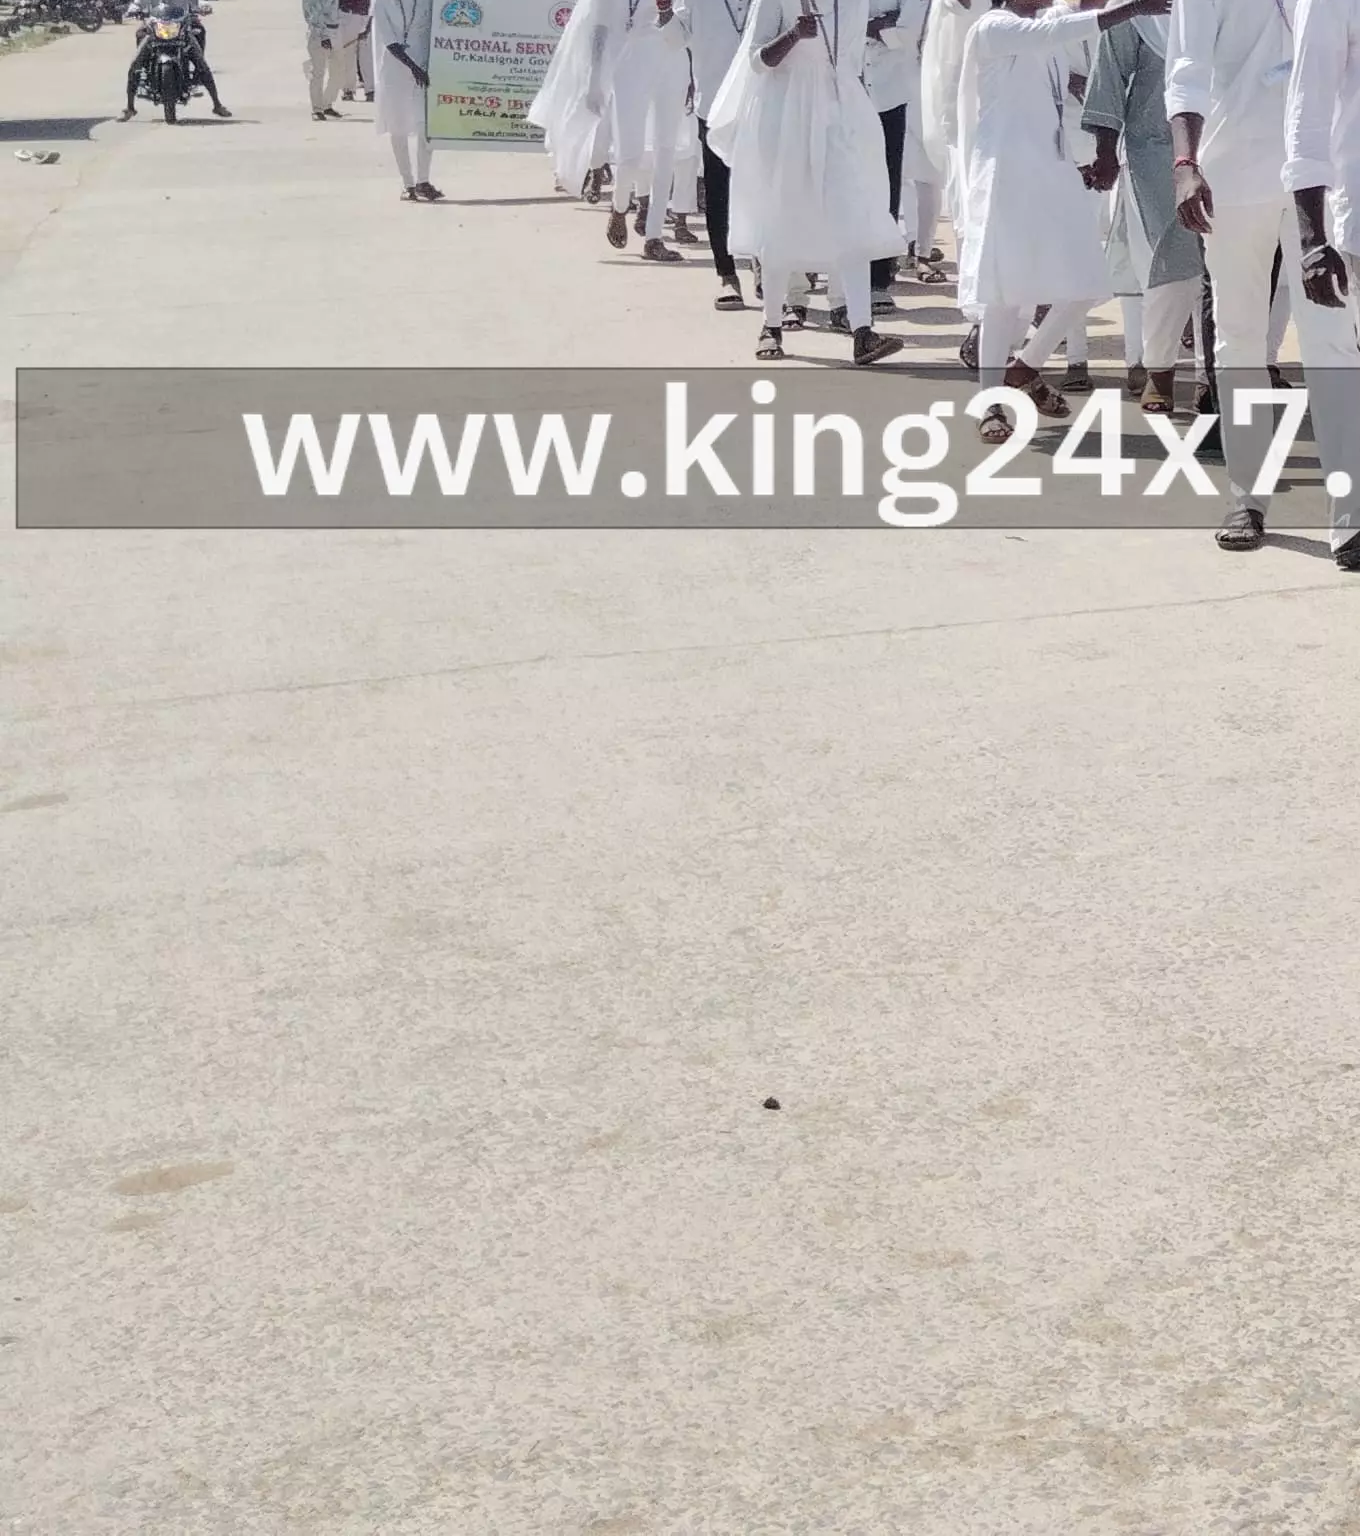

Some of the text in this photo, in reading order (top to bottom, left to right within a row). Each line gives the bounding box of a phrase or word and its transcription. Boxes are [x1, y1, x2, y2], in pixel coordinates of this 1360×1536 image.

[434, 37, 557, 55] NATIONAL SERV
[529, 57, 552, 66] Gov
